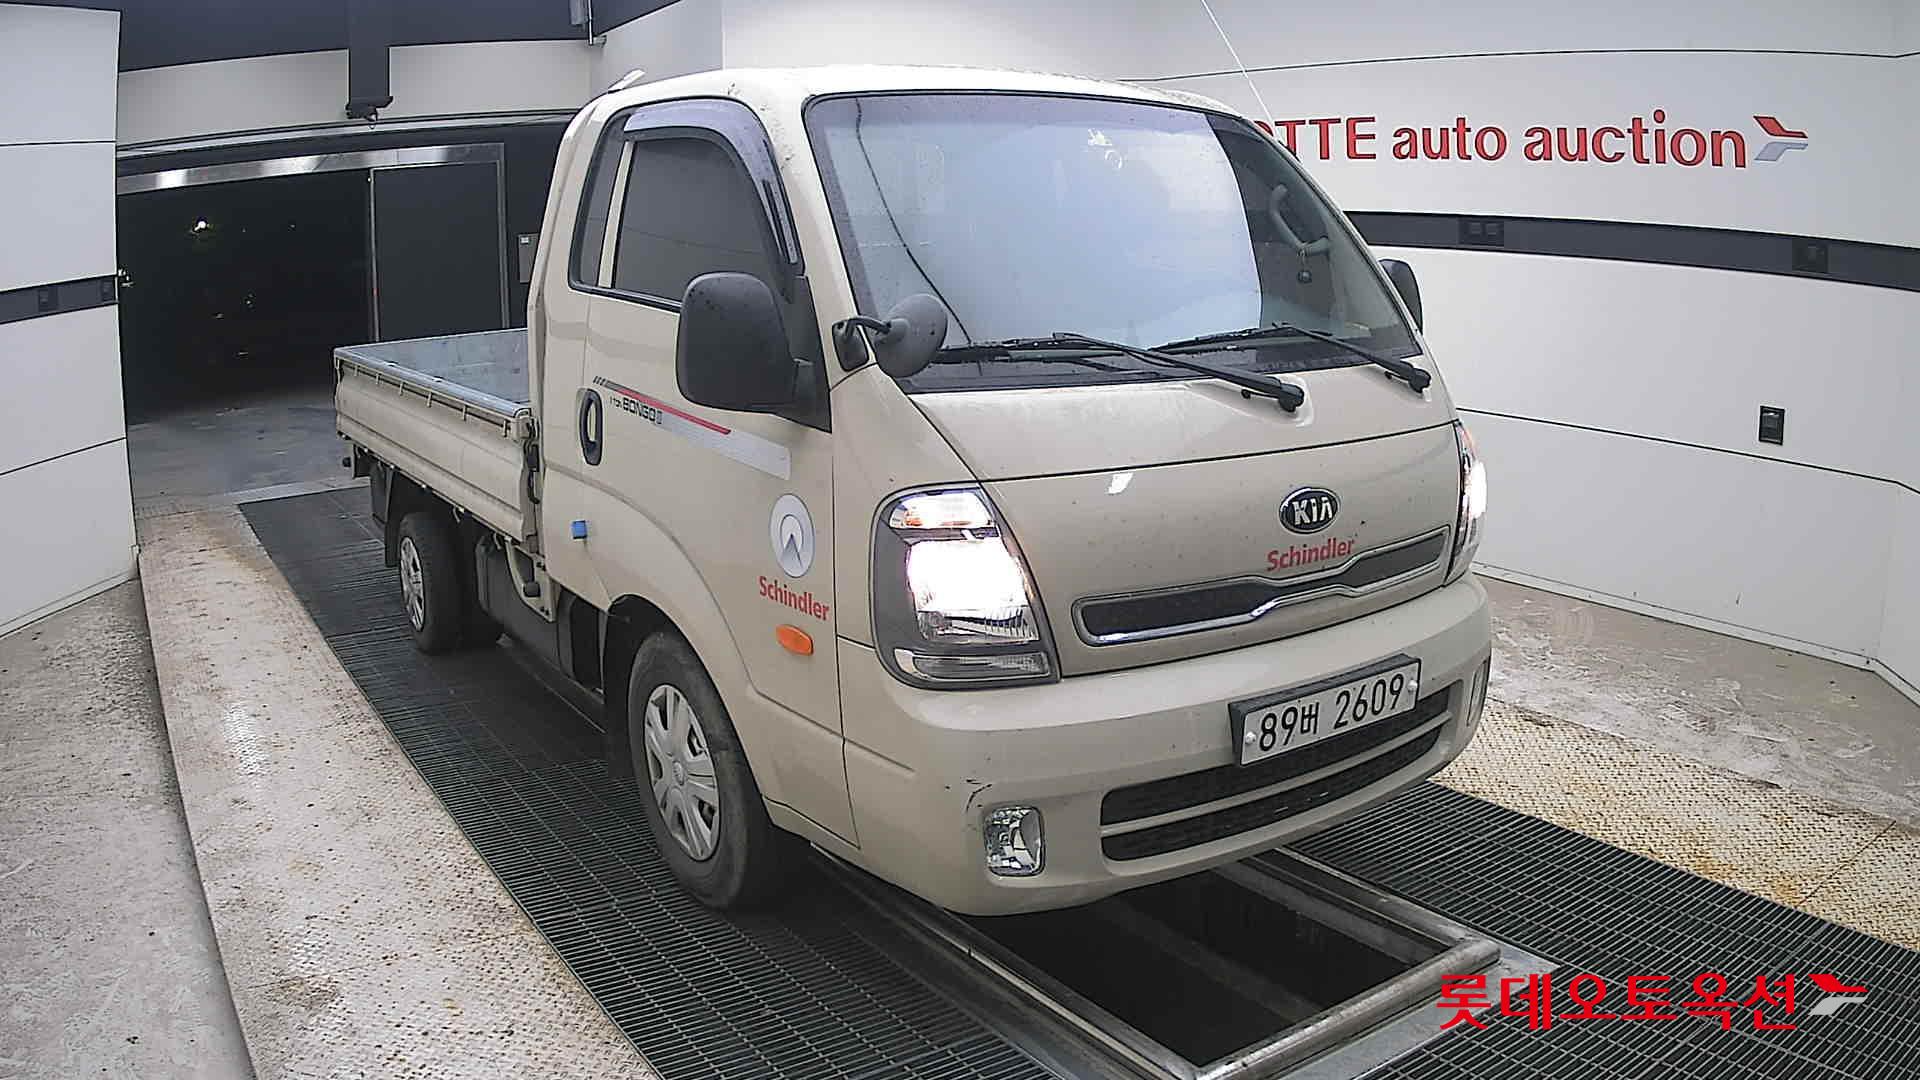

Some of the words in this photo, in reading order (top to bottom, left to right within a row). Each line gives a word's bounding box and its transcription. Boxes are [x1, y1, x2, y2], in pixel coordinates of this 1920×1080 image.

[1254, 116, 1377, 160] TTE
[1392, 117, 1508, 161] auto
[1524, 109, 1747, 168] auction
[1292, 496, 1333, 525] KIA
[1267, 537, 1355, 571] Schindler
[758, 575, 830, 621] Schindler
[1259, 701, 1320, 752] 89버
[1333, 673, 1404, 730] 2609
